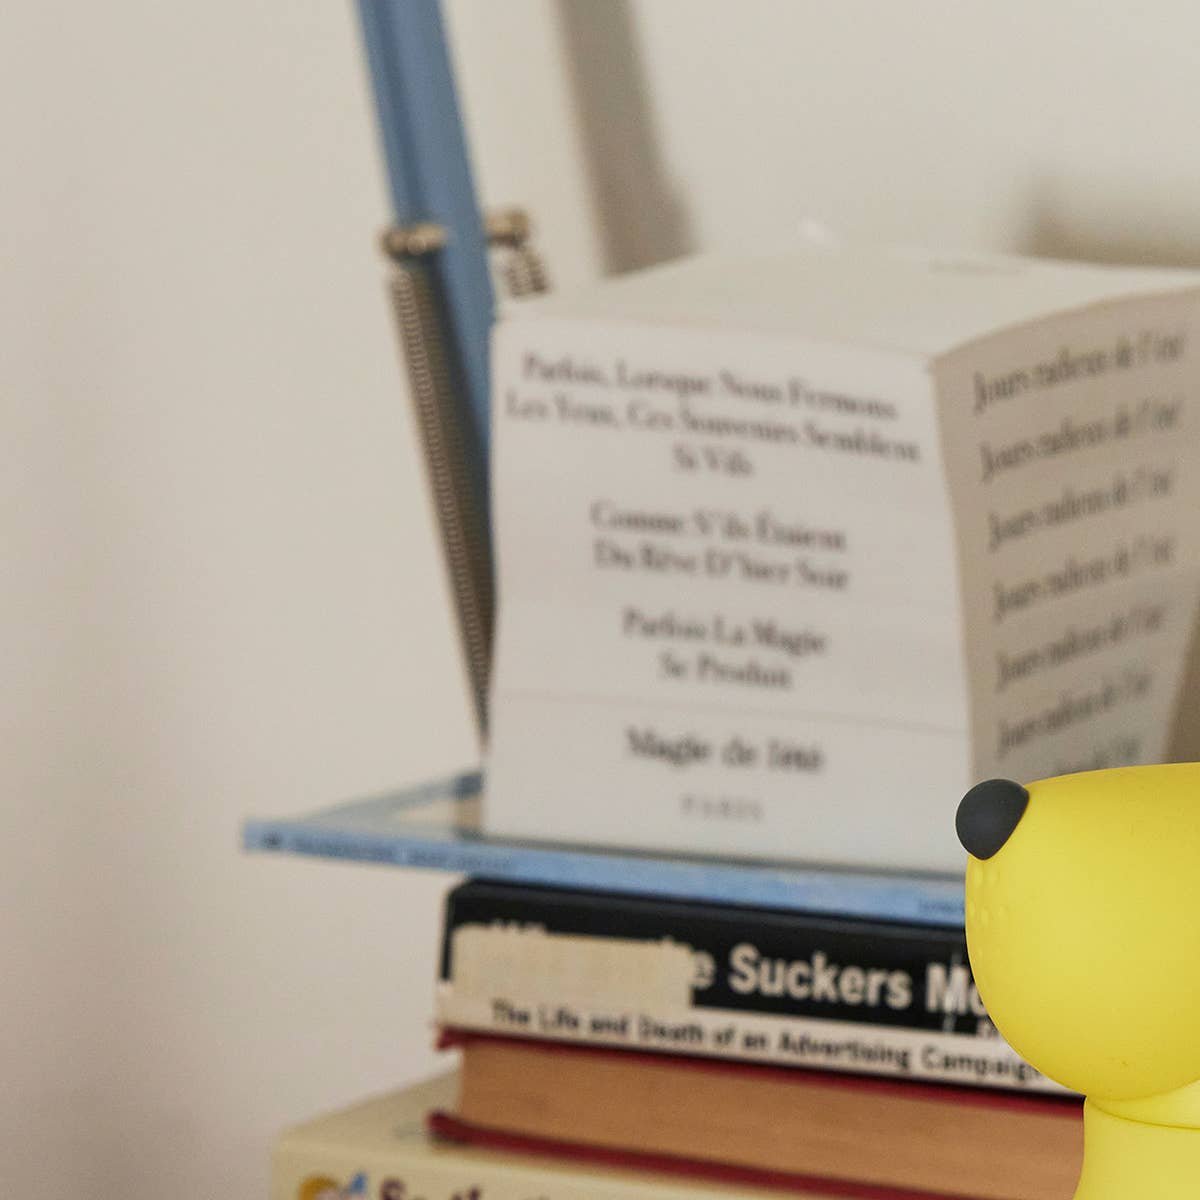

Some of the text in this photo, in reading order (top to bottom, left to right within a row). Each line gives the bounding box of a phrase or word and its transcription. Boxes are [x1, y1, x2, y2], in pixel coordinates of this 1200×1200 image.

[727, 943, 912, 1008] Suckers
[538, 1004, 582, 1033] Life
[590, 1010, 630, 1039] and
[640, 1014, 704, 1046] Death
[713, 1020, 736, 1048] of
[743, 1028, 771, 1052] an
[779, 1028, 912, 1073] Advertising
